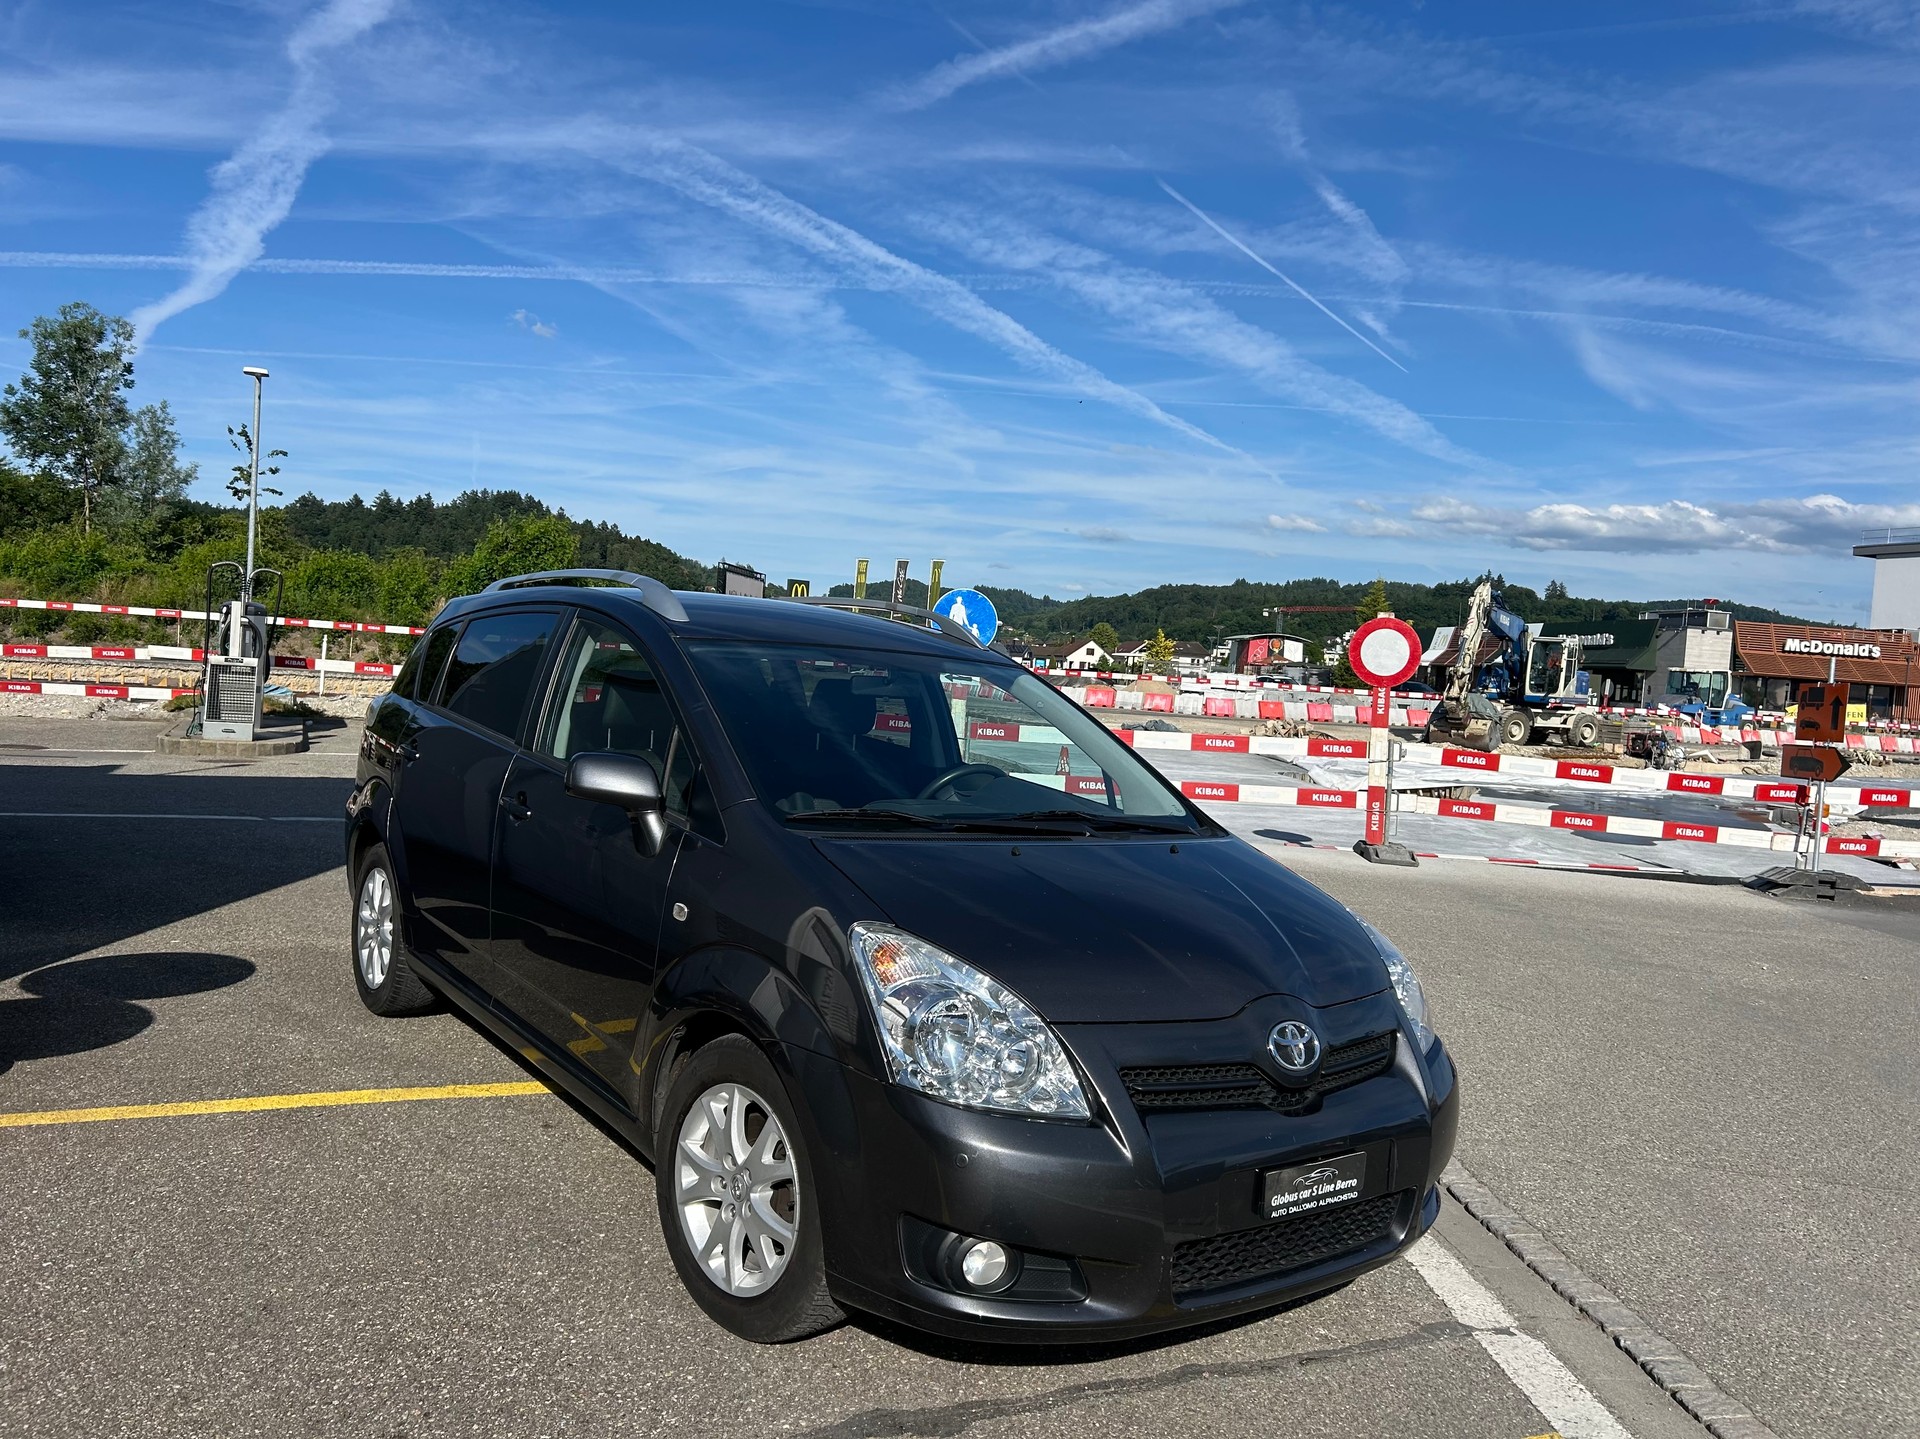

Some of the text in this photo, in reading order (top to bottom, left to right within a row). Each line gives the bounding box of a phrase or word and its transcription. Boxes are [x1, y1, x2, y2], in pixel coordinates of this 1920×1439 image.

[13, 647, 37, 655] KIBAG
[1784, 638, 1881, 658] McDonald's
[284, 659, 306, 667] KIBAG
[8, 683, 32, 691] KIBAG
[977, 727, 1005, 737] KIBAG
[1205, 738, 1235, 748] KIBAG
[1322, 744, 1353, 754] KIBAG
[1456, 754, 1486, 765] KIBAG
[1570, 767, 1599, 777] KIBAG
[1682, 778, 1711, 789] KIBAG
[1195, 786, 1225, 796] KIBAG
[1769, 789, 1797, 798] KIBAG
[1312, 793, 1342, 803] KIBAG
[1871, 793, 1897, 802] KIBAG
[1452, 804, 1481, 815] KIBAG
[1371, 801, 1380, 831] KIBAG
[1564, 816, 1593, 827] KIBAG
[1675, 827, 1704, 838] KIBAG
[1839, 842, 1867, 852] KIBAG
[1271, 1179, 1358, 1207] Globus car S Line Berro
[1271, 1191, 1358, 1218] AUTO DALL'OMO ALPNACHSTAD
